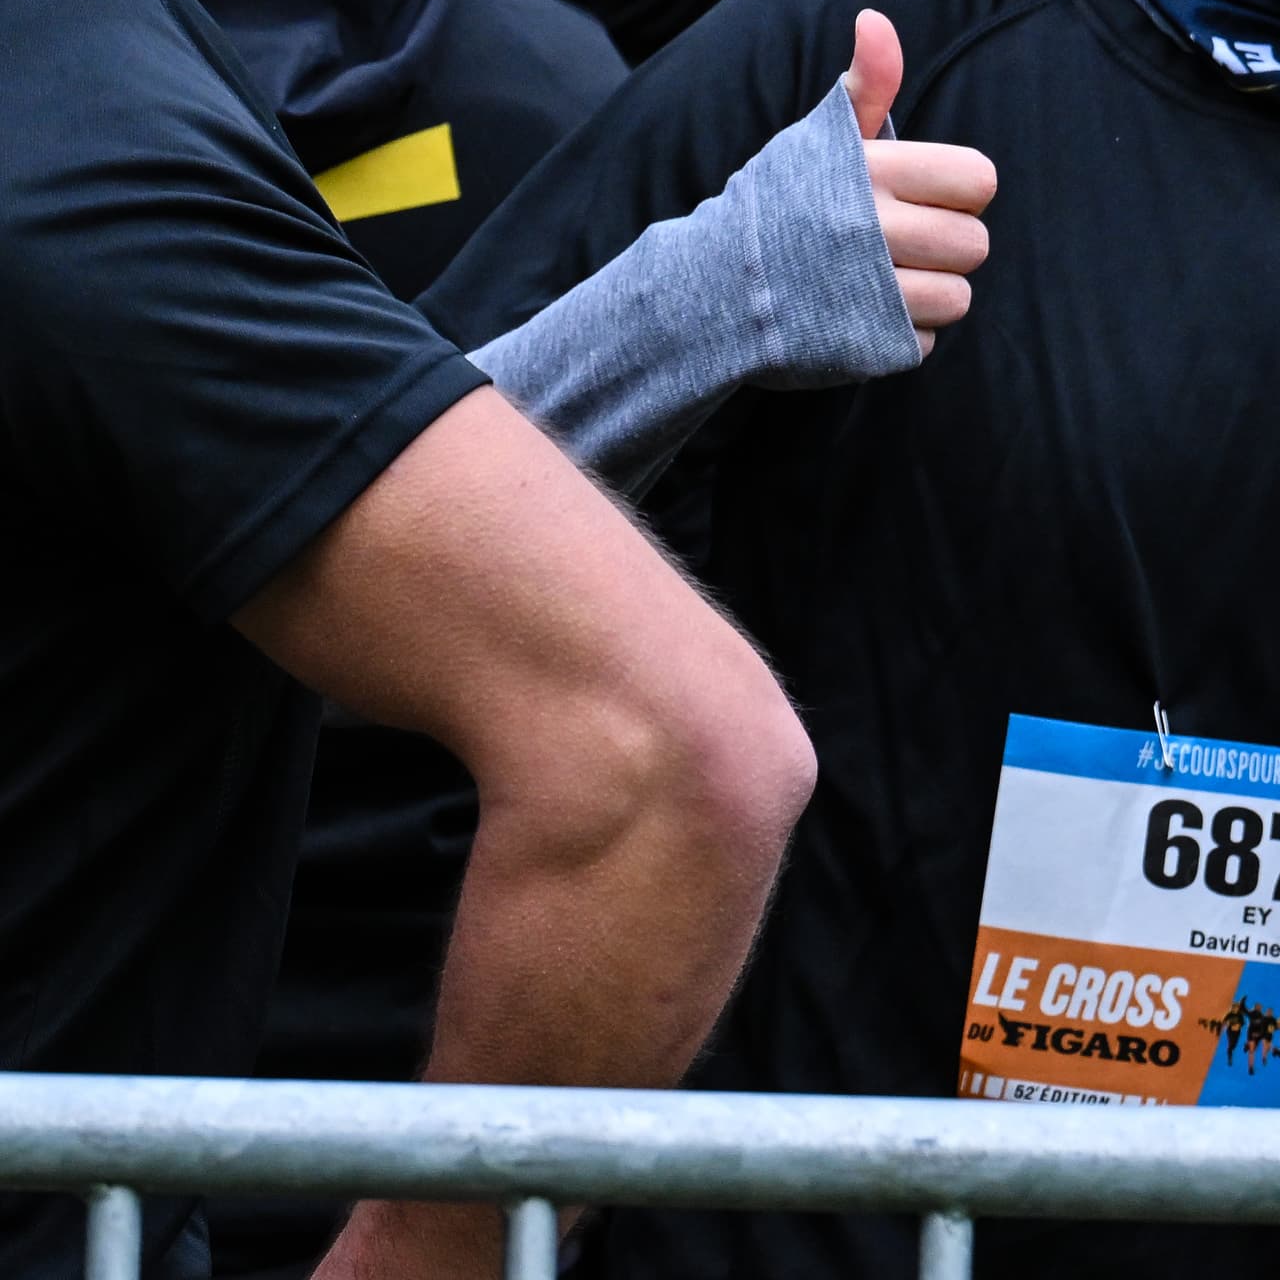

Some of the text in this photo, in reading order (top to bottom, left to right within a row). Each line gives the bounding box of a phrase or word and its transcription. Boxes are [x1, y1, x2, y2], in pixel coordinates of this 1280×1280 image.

[1242, 905, 1273, 926] EY
[1189, 930, 1250, 954] David
[972, 952, 1191, 1032] LE CROSS
[967, 1014, 1181, 1068] DU FIGARO
